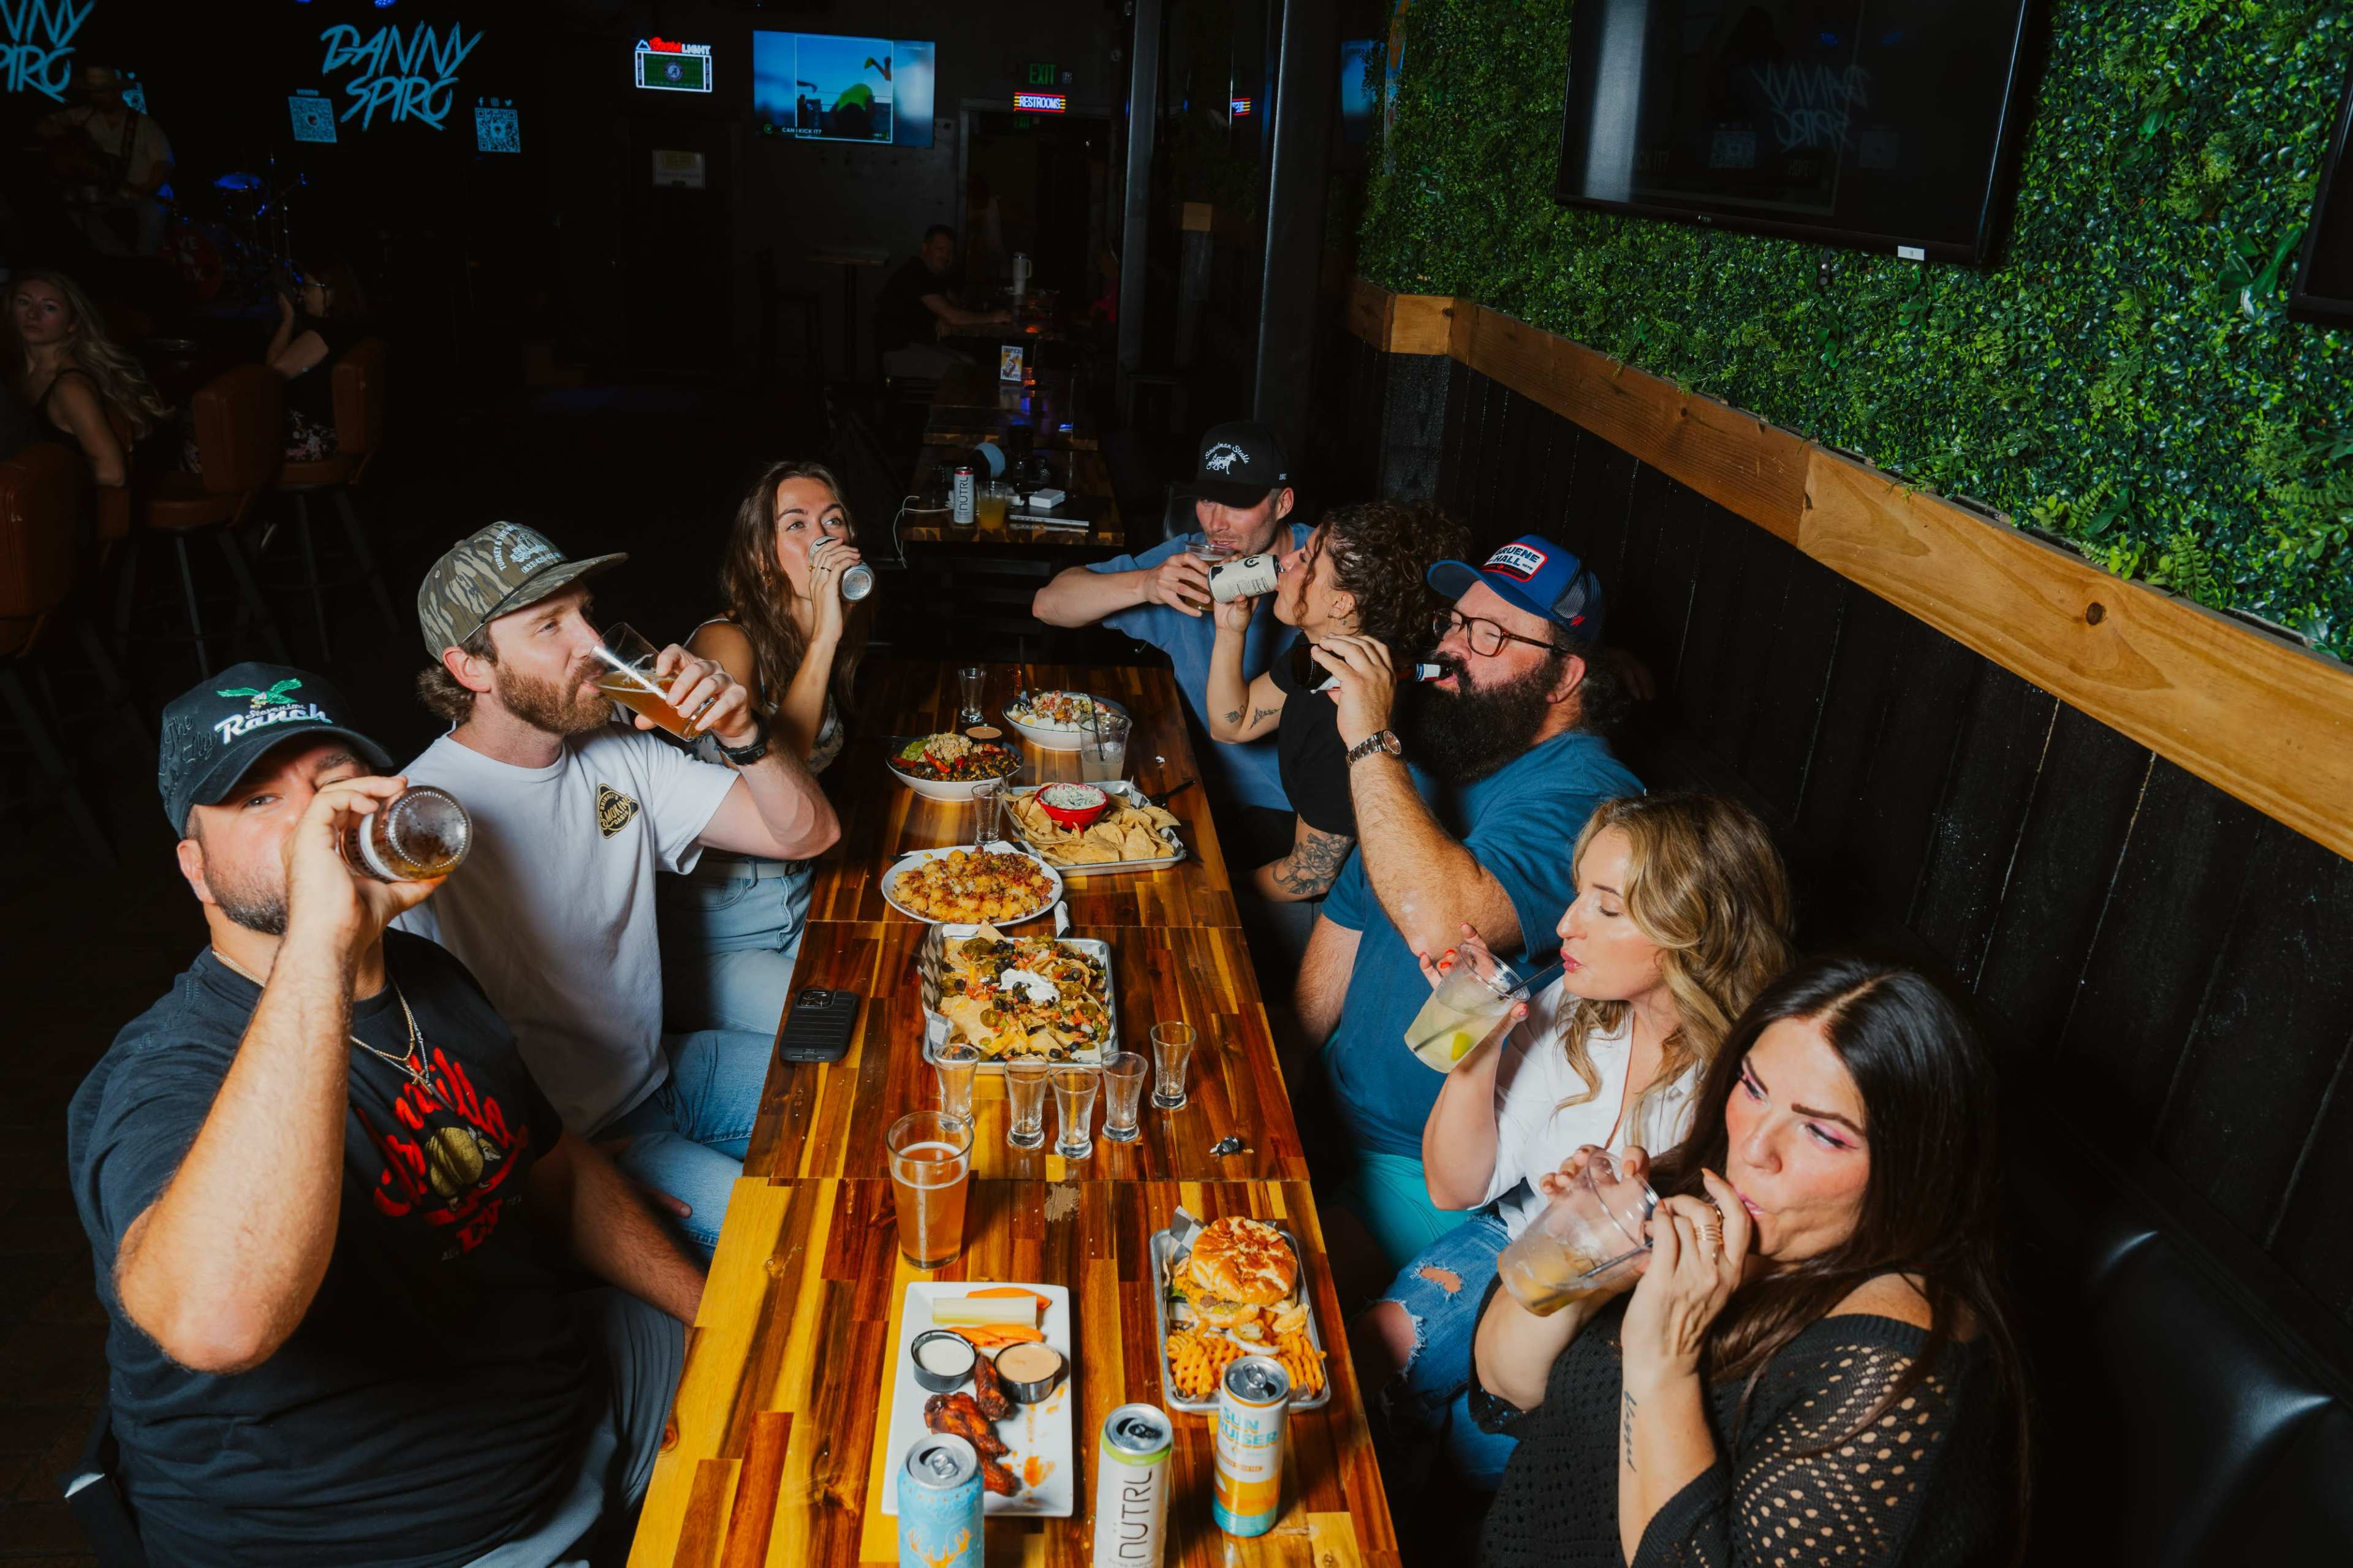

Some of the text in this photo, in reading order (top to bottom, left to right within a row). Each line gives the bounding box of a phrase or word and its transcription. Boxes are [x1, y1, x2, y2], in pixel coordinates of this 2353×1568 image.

[319, 19, 487, 77] DANNY
[681, 44, 711, 55] LIGHT
[1029, 63, 1057, 85] EXIT
[1019, 95, 1061, 110] RESTROOMS
[496, 529, 510, 540] THE
[493, 546, 507, 571] TURKEY
[1493, 555, 1520, 566] HALL
[1495, 547, 1540, 563] GRUENE
[214, 703, 333, 745] Ranch
[613, 809, 629, 825] OASIS
[1223, 1406, 1259, 1432] SUN
